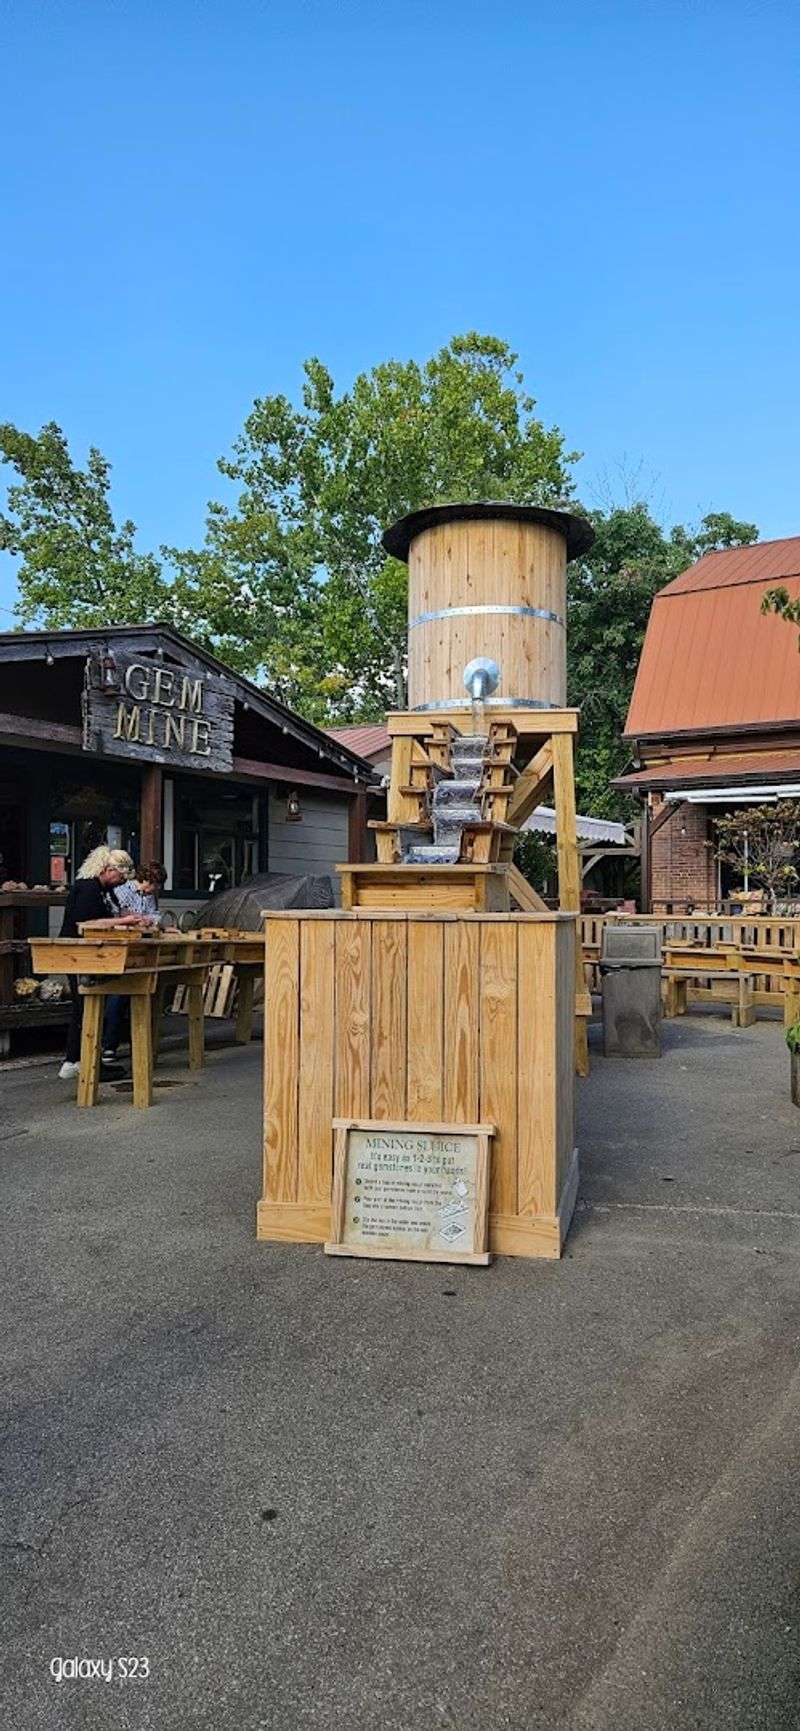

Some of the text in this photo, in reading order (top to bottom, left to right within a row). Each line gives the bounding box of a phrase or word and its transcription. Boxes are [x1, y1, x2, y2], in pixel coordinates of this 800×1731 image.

[125, 664, 204, 714] GEM
[112, 701, 212, 757] MINE
[366, 1137, 461, 1153] MINING SLUICE
[357, 1162, 372, 1170] real
[383, 1153, 400, 1163] easy
